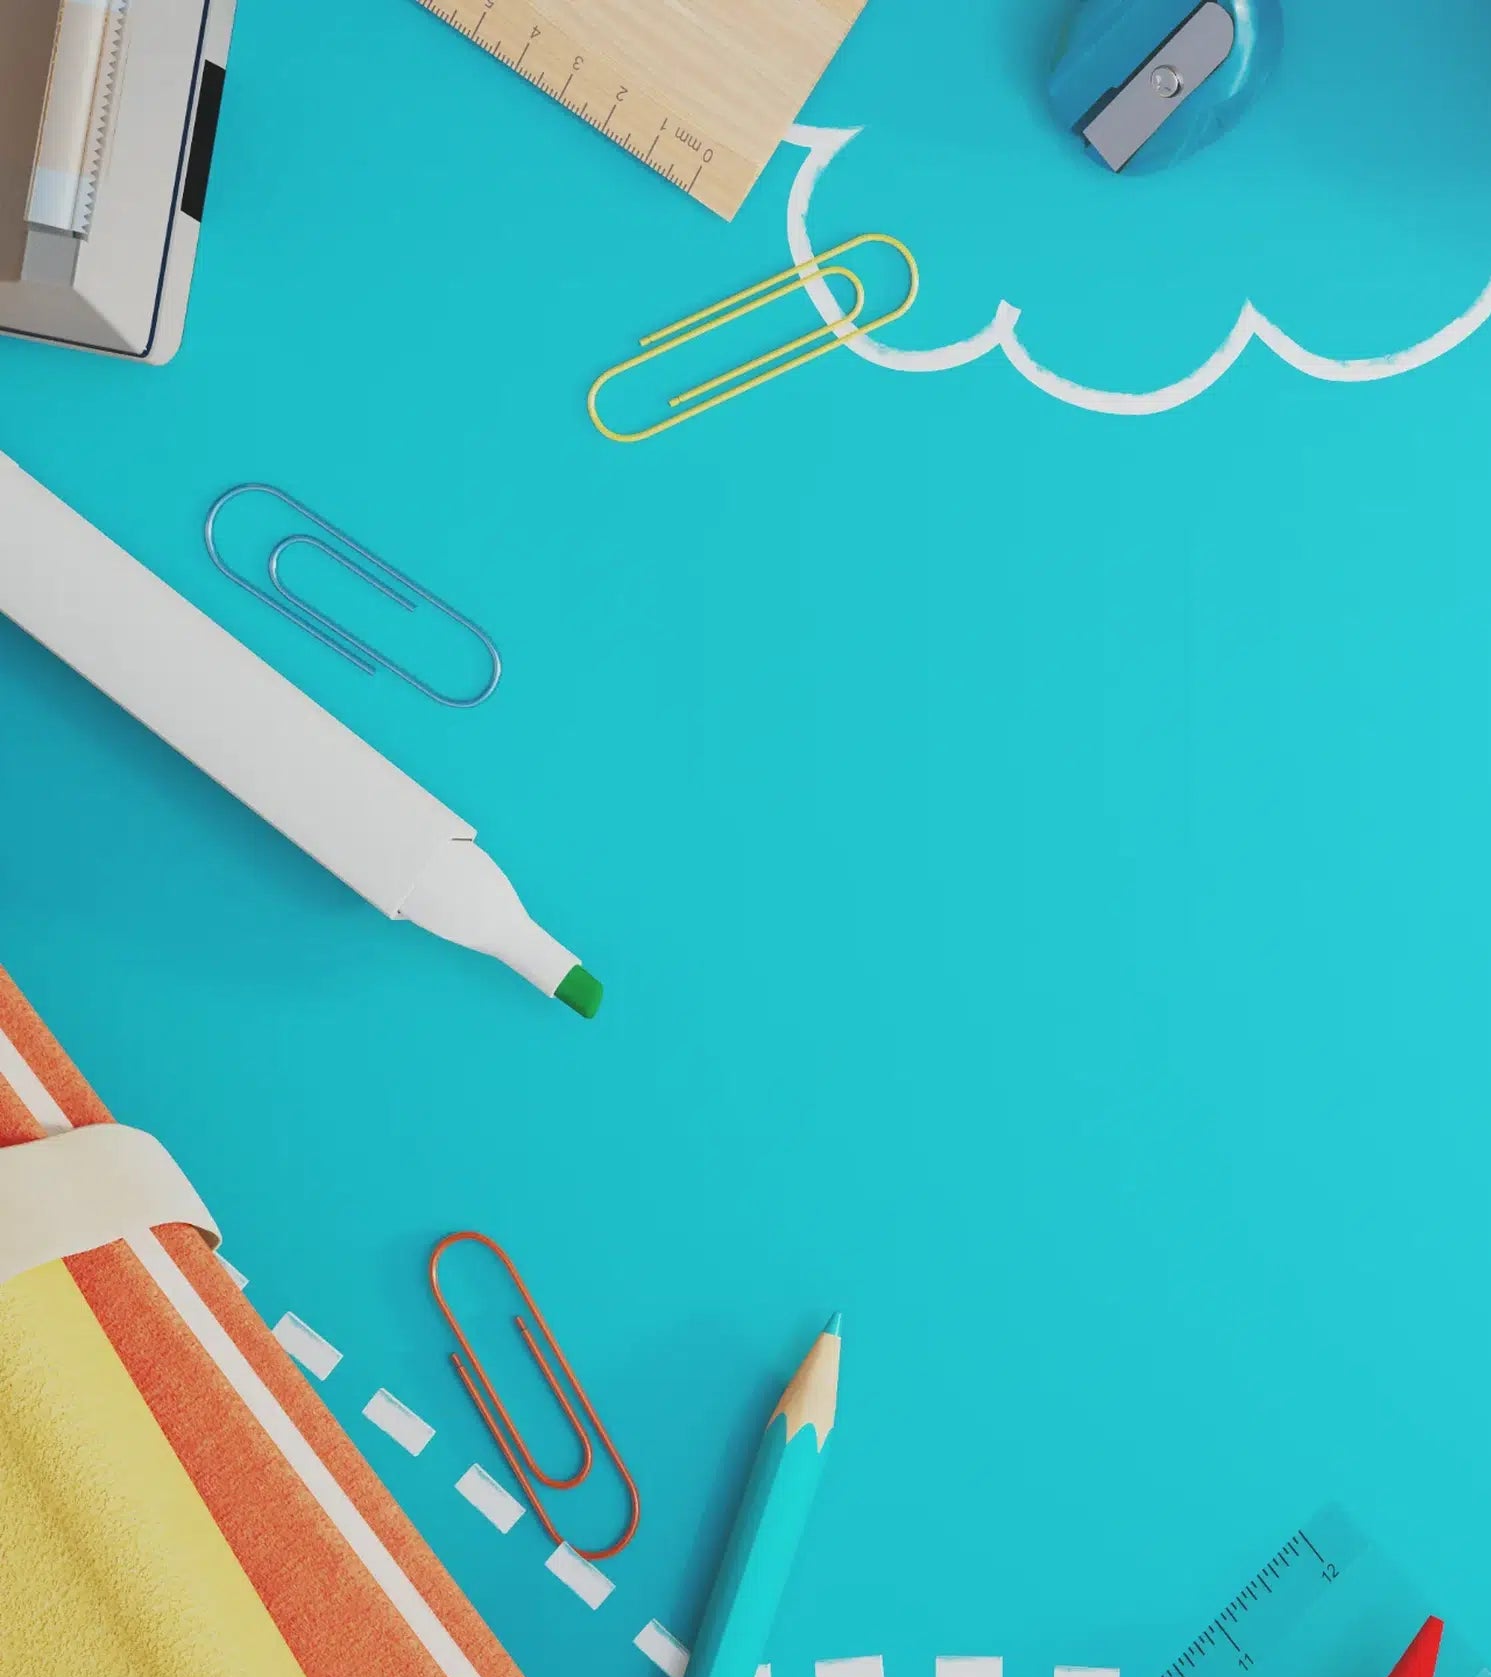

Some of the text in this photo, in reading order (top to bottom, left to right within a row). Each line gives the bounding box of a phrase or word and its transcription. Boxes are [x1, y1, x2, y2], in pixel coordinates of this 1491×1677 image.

[531, 25, 541, 39] 4
[572, 55, 584, 71] 3
[616, 86, 628, 102] 2
[660, 117, 668, 131] 1
[674, 127, 702, 152] mm
[702, 149, 714, 163] 0
[1238, 1653, 1254, 1671] 11
[1321, 1563, 1340, 1583] 12
